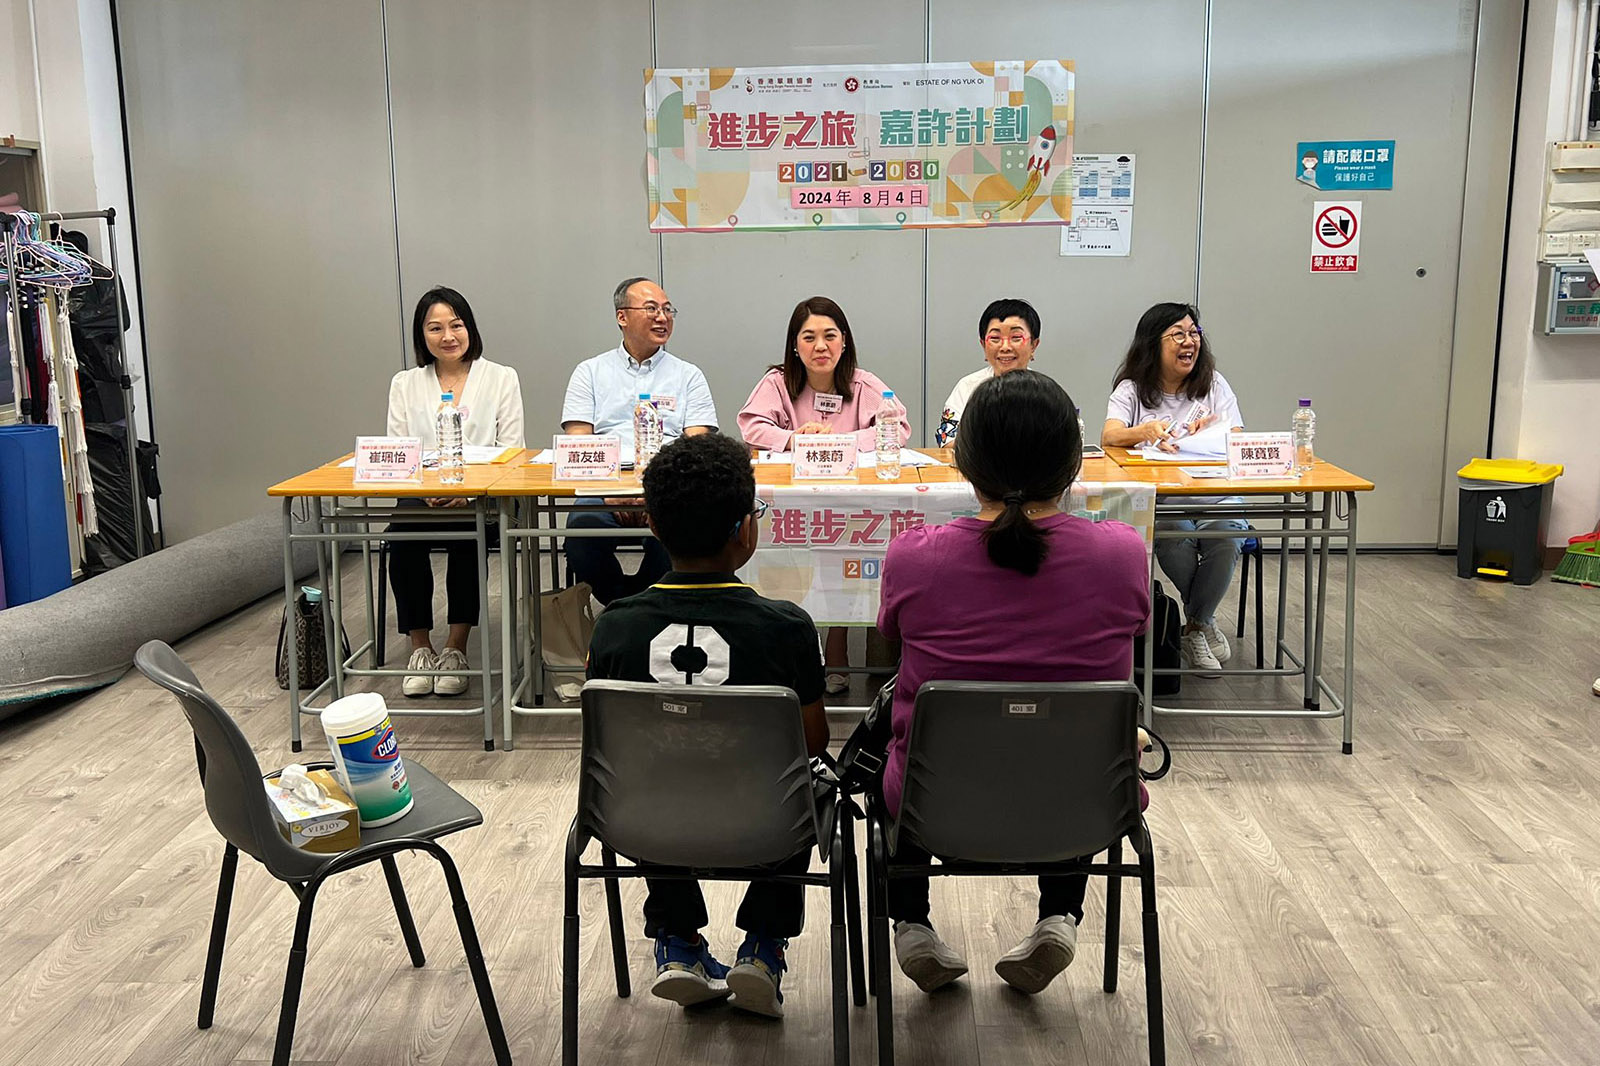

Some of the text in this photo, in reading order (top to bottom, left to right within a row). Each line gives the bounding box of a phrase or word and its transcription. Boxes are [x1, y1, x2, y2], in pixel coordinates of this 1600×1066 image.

[708, 105, 1030, 148] 進步之旅 嘉許計劃
[1322, 148, 1389, 164] 請配戴口罩
[782, 163, 937, 180] 2021 2030
[1334, 172, 1375, 182] 保護好自己
[799, 190, 922, 206] 2024 年 8 月 4 日
[1314, 256, 1355, 267] 禁止飲食
[568, 451, 606, 464] 蕭友雄
[806, 450, 844, 462] 林素蔚
[1241, 447, 1280, 460] 陳寶賢
[308, 822, 339, 833] VIRJOY
